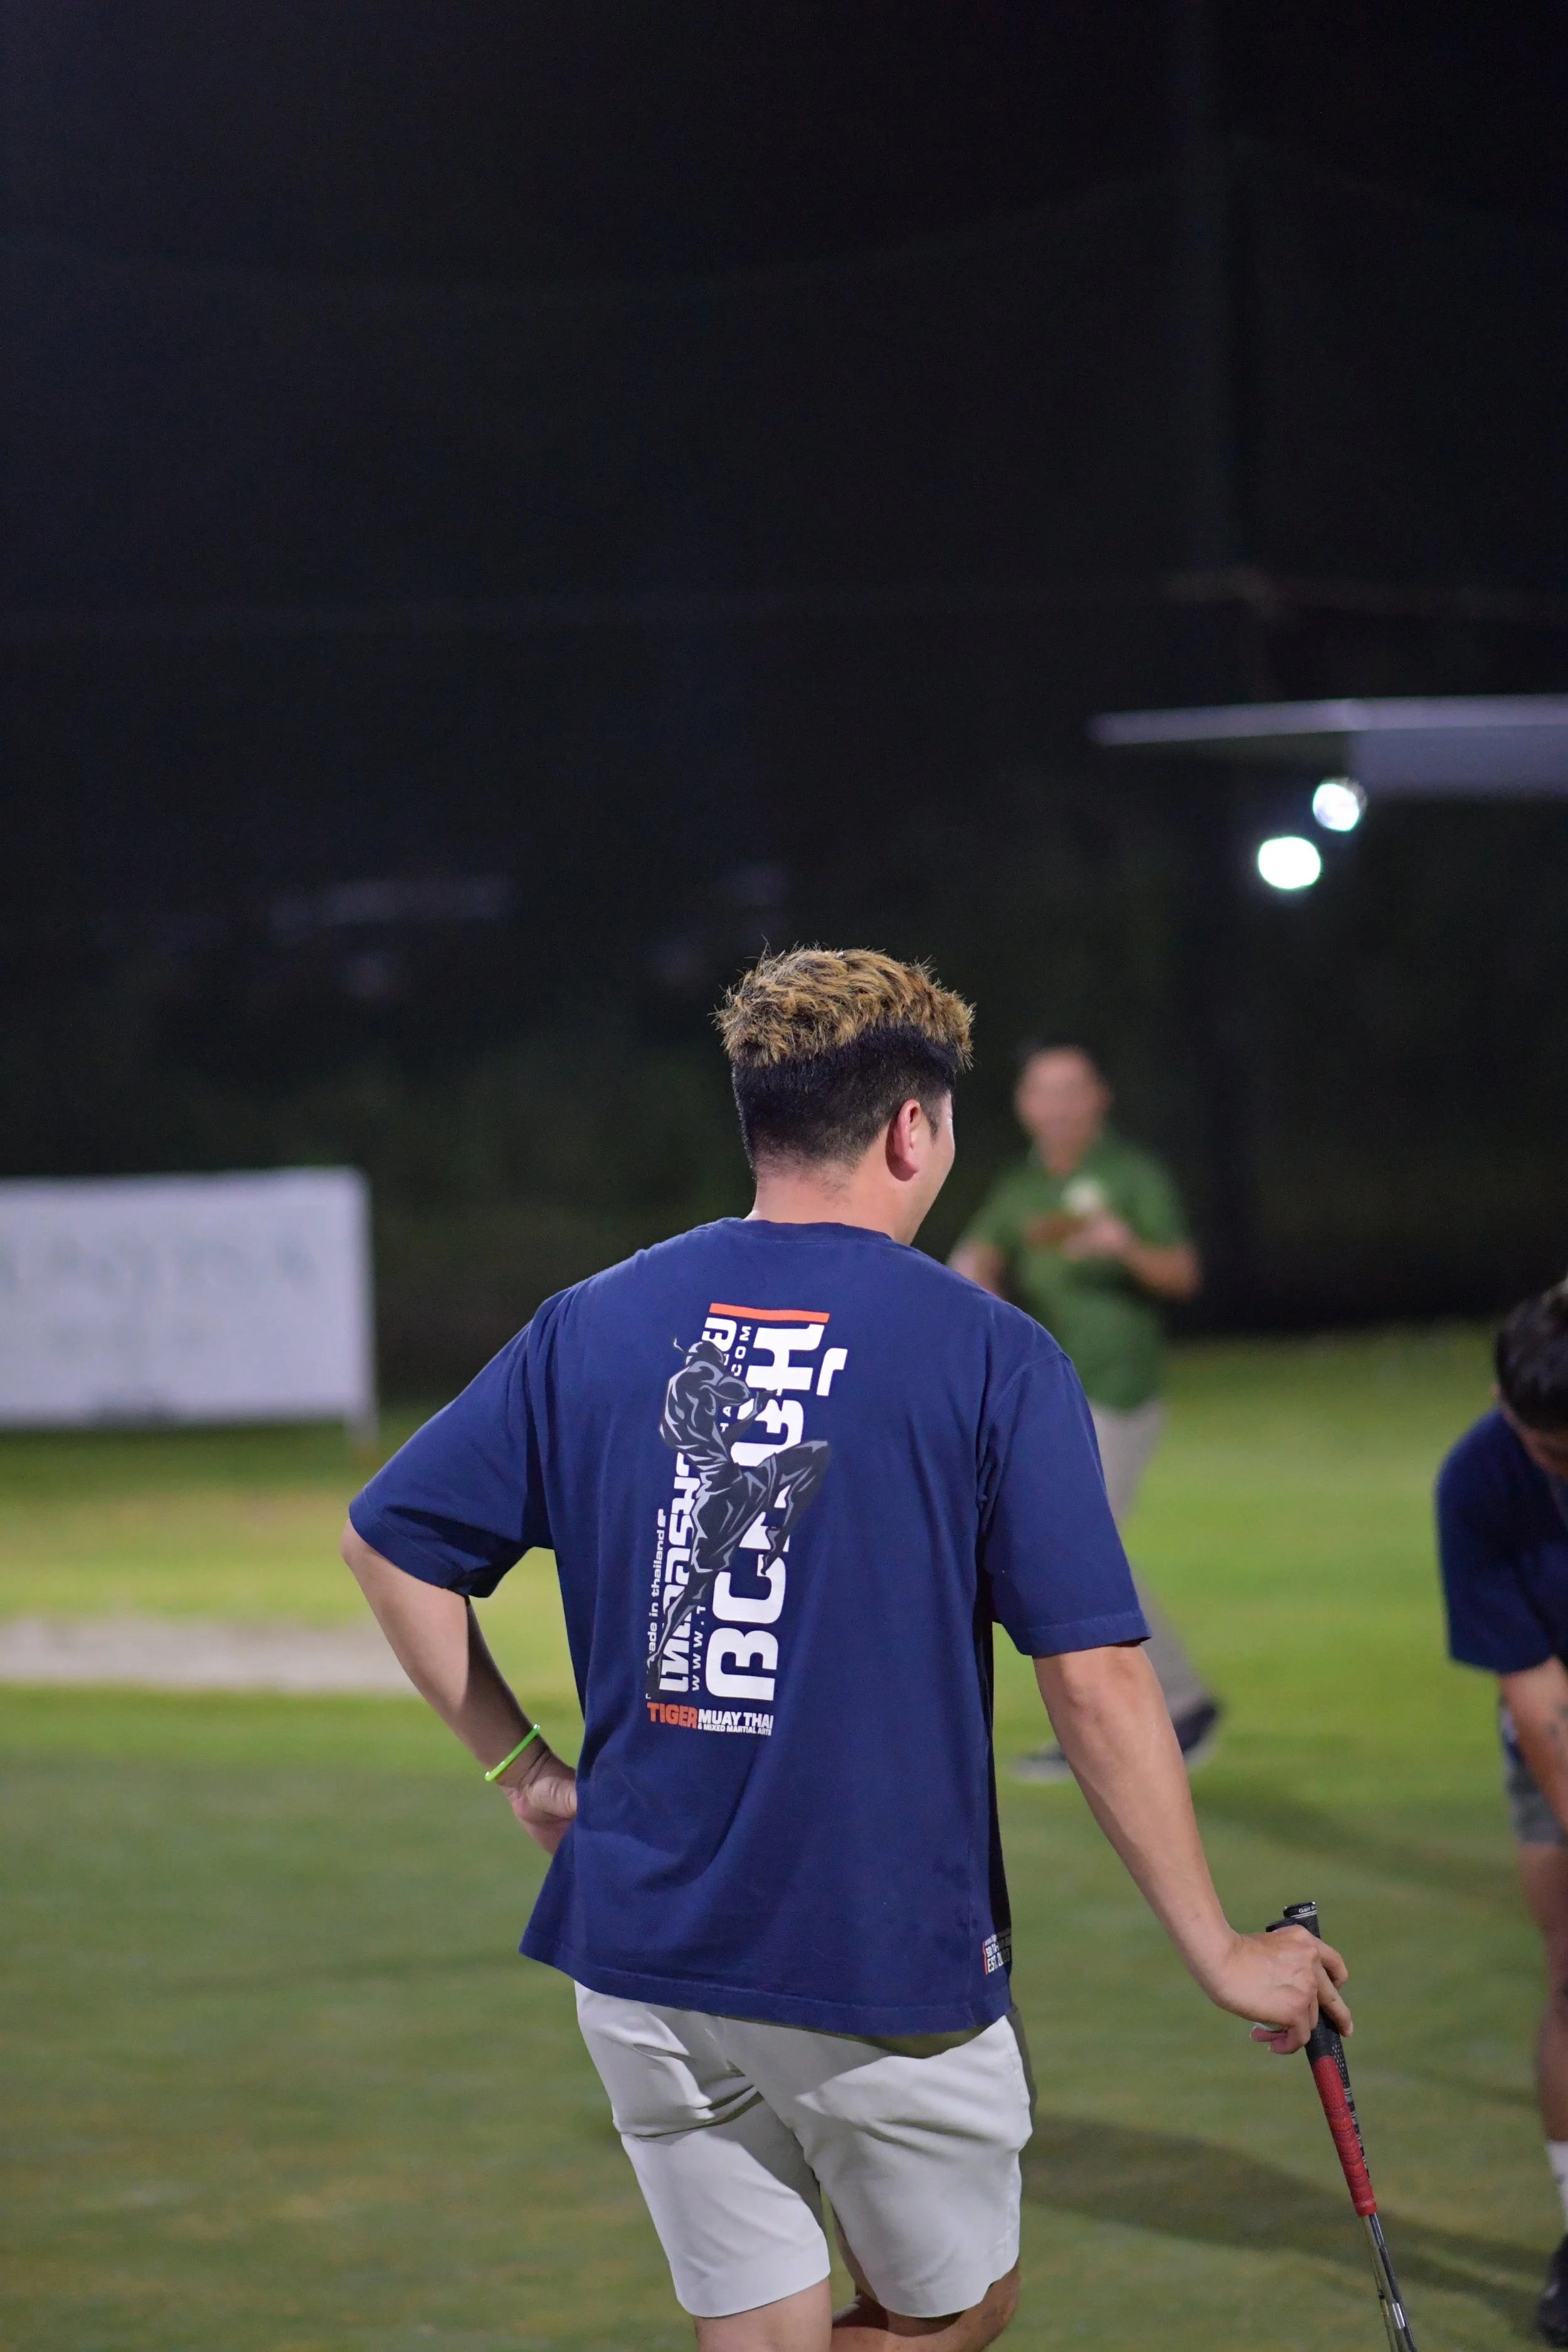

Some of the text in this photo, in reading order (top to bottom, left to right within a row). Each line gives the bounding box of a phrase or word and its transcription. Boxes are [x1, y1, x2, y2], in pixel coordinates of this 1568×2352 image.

[647, 1530, 665, 1655] ade in thailand
[647, 1702, 774, 1729] TIGER MUAY THAI
[704, 1724, 726, 1732] MIXED
[726, 1725, 756, 1734] MARTIAL
